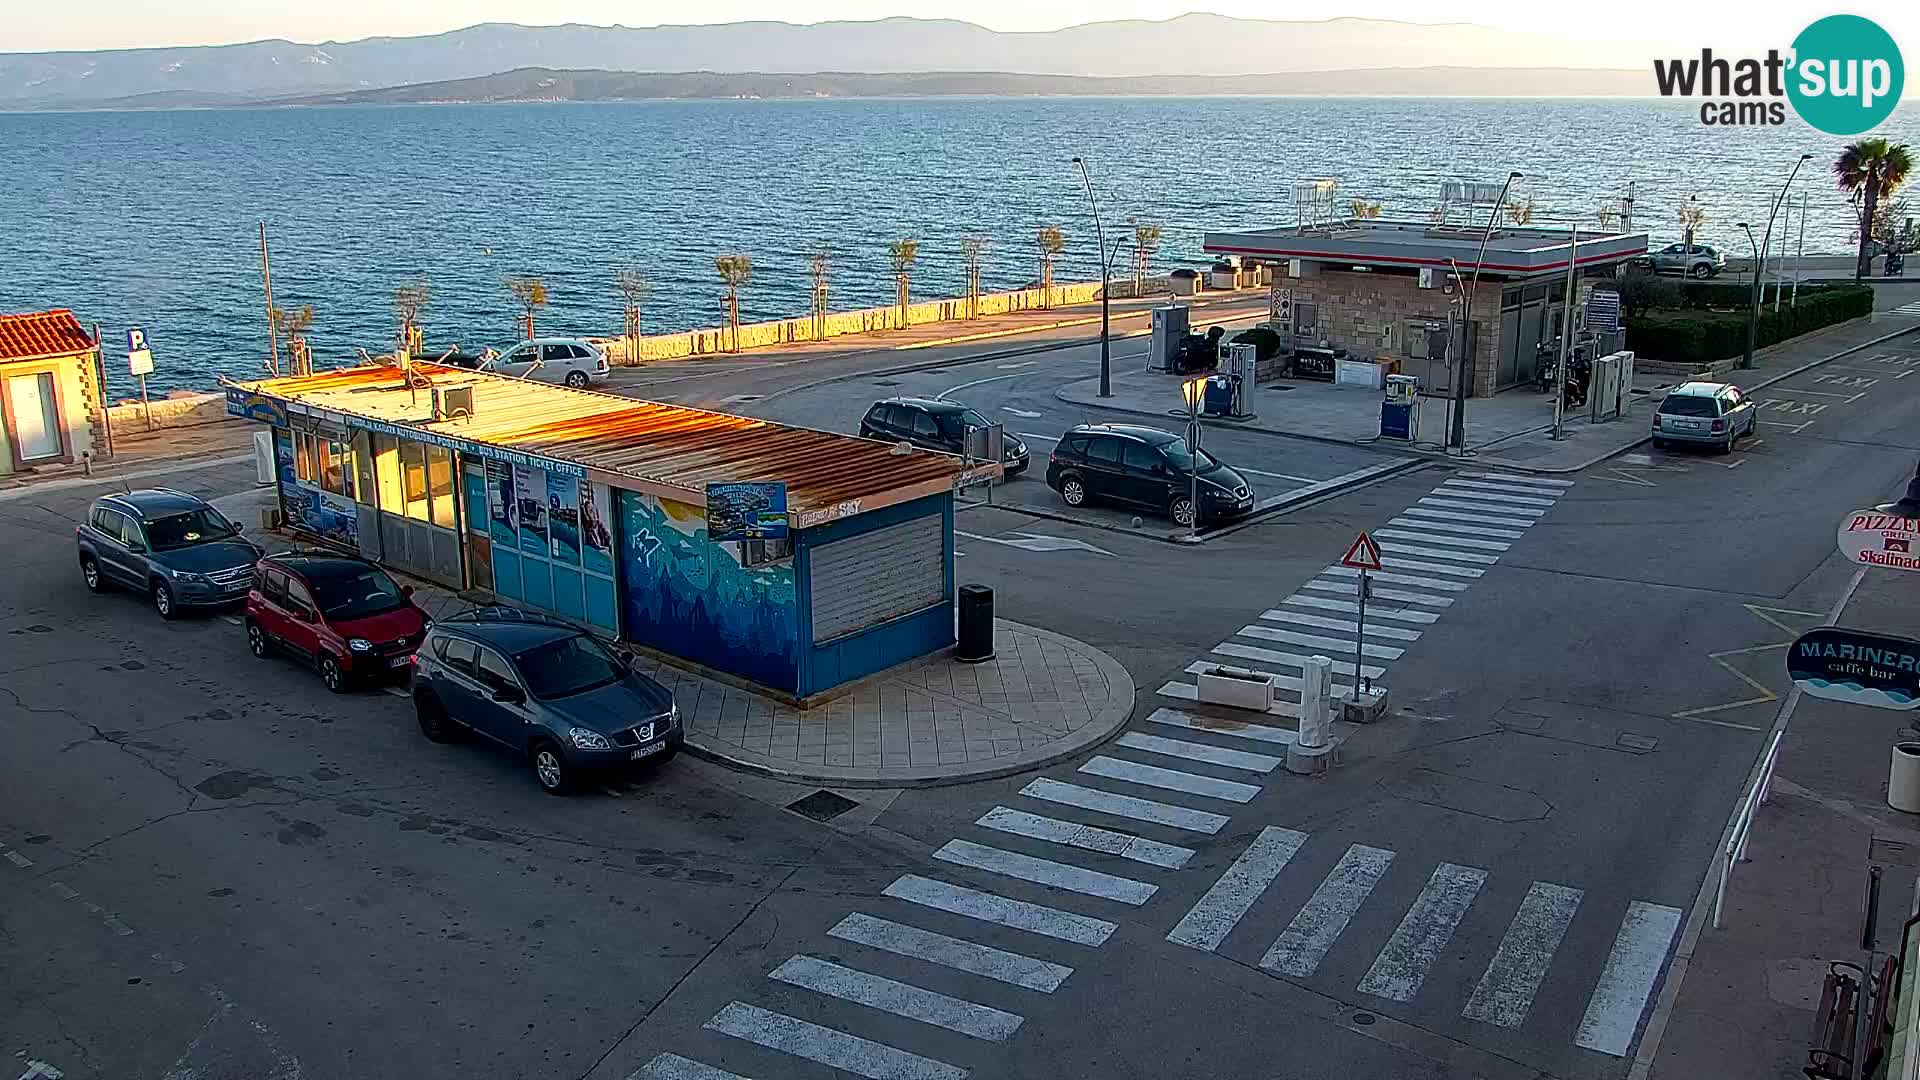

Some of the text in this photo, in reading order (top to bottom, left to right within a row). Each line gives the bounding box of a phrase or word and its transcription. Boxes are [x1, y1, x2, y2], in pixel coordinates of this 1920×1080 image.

[130, 330, 144, 350] P
[1814, 373, 1880, 389] TAXI
[1757, 397, 1830, 415] TAXI
[437, 437, 468, 451] POSTAJA
[479, 445, 494, 457] BUS
[495, 449, 527, 465] STATION
[528, 456, 555, 471] TICKET
[556, 463, 583, 477] OFFICE
[1848, 515, 1920, 533] PIZZE
[1828, 663, 1896, 680] caffe bar
